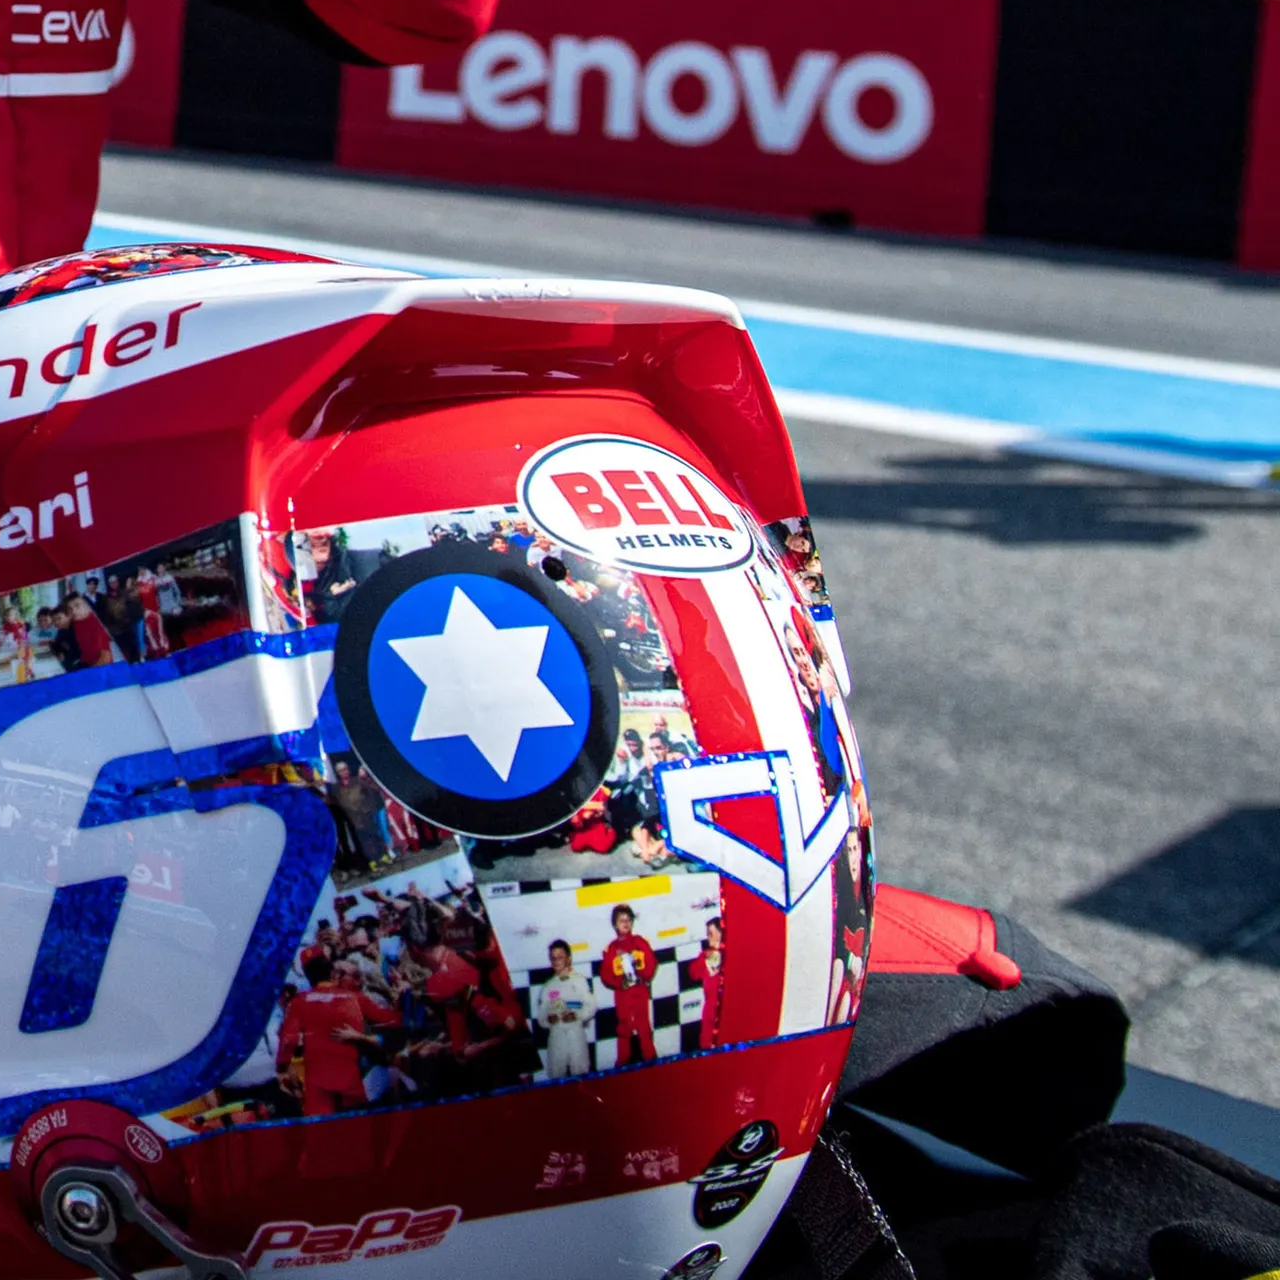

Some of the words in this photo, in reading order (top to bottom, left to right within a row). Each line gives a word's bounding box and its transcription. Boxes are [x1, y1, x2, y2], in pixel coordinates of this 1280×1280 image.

[388, 30, 932, 164] Lenovo
[550, 470, 736, 531] BELL
[615, 533, 733, 550] HELMETS
